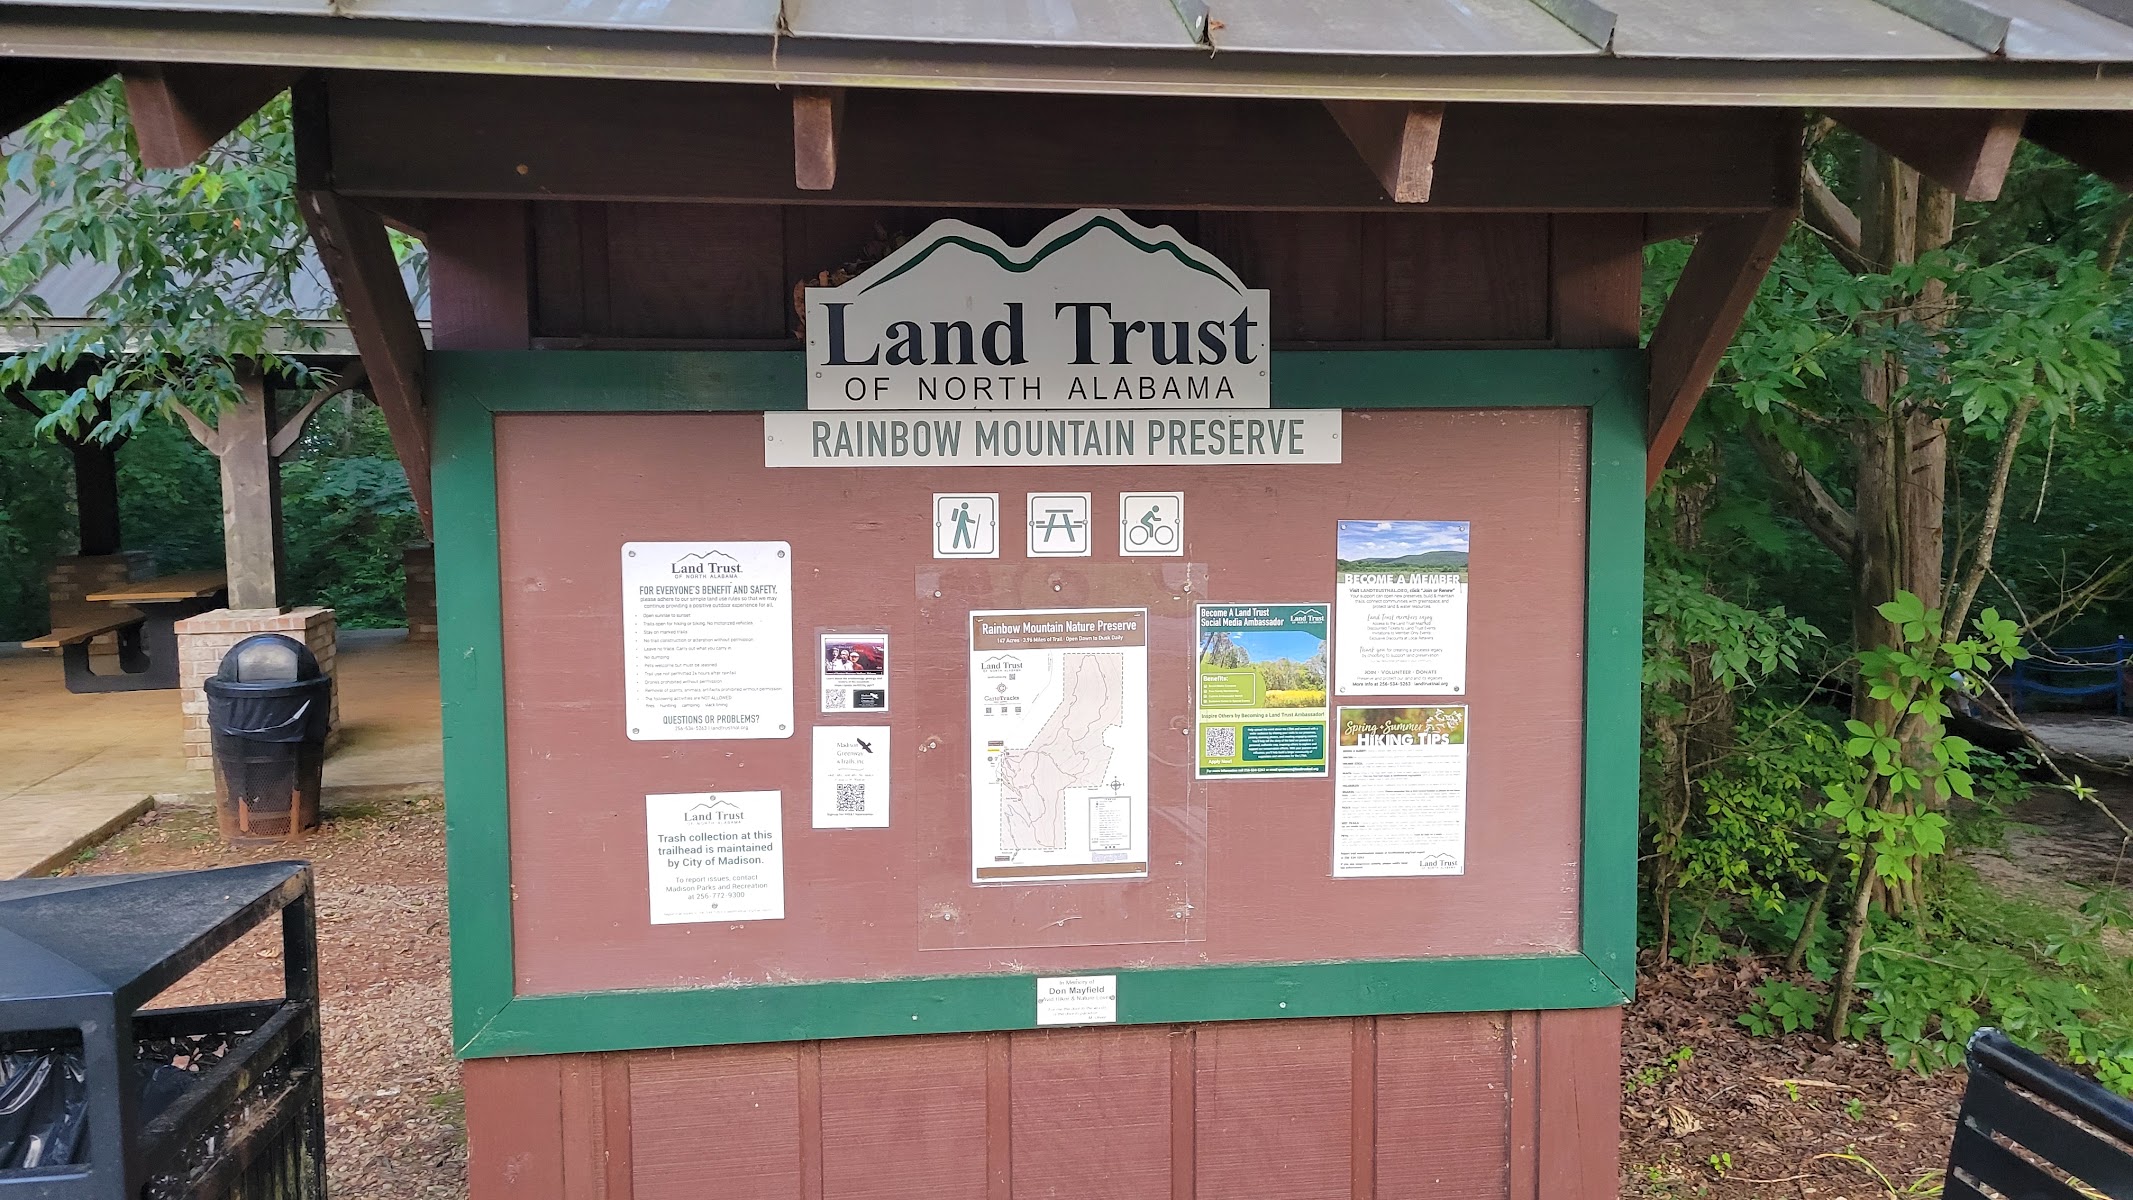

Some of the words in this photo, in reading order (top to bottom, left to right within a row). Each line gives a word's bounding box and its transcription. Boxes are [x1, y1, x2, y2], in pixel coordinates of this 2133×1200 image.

[819, 301, 1030, 367] Land
[1055, 301, 1259, 367] Trust
[845, 376, 889, 401] OF
[919, 376, 1042, 400] NORTH
[1068, 375, 1234, 400] ALABAMA
[812, 420, 962, 458] RAINBOW
[975, 420, 1134, 457] MOUNTAIN
[1148, 419, 1305, 456] PRESERVE
[671, 562, 704, 574] Land
[707, 562, 741, 573] Trust
[1345, 573, 1394, 584] BECOME
[1397, 574, 1406, 584] A
[1410, 573, 1460, 584] MEMBER
[639, 585, 654, 595] FOR
[656, 585, 700, 595] EVERYONE'S
[702, 585, 732, 595] BENEFIT
[733, 585, 748, 594] AND
[750, 584, 778, 595] SAFETY,
[1201, 608, 1227, 617] Become
[1229, 608, 1234, 617] A
[1235, 607, 1251, 616] Land
[1252, 607, 1270, 617] Trust
[982, 623, 1020, 635] Rainbow
[1022, 621, 1063, 634] Mountain
[1066, 620, 1095, 632] Nature
[1097, 619, 1137, 632] Preserve
[1201, 618, 1221, 627] Social
[1223, 618, 1242, 626] Media
[1243, 618, 1285, 626] Ambassador
[981, 662, 1001, 670] Land
[1003, 661, 1023, 670] Trust
[663, 715, 703, 725] QUESTIONS
[704, 715, 715, 724] OR
[717, 714, 760, 724] PROBLEMS?
[1345, 720, 1378, 736] Spring
[1383, 720, 1423, 734] Summer
[1357, 734, 1413, 746] HIKING
[1418, 733, 1450, 745] TIPS
[684, 812, 712, 821] Land
[715, 811, 744, 820] Trust
[657, 833, 686, 843] Trash
[689, 831, 738, 842] collection
[741, 832, 751, 840] at
[753, 830, 773, 839] this
[658, 845, 703, 856] trailhead
[705, 844, 714, 854] is
[717, 842, 773, 853] maintained
[667, 858, 680, 869] by
[682, 857, 702, 868] City
[705, 856, 716, 866] of
[718, 856, 764, 865] Madison.
[685, 876, 706, 884] report
[1049, 987, 1067, 995] Don
[1069, 985, 1105, 995] Mayfield
